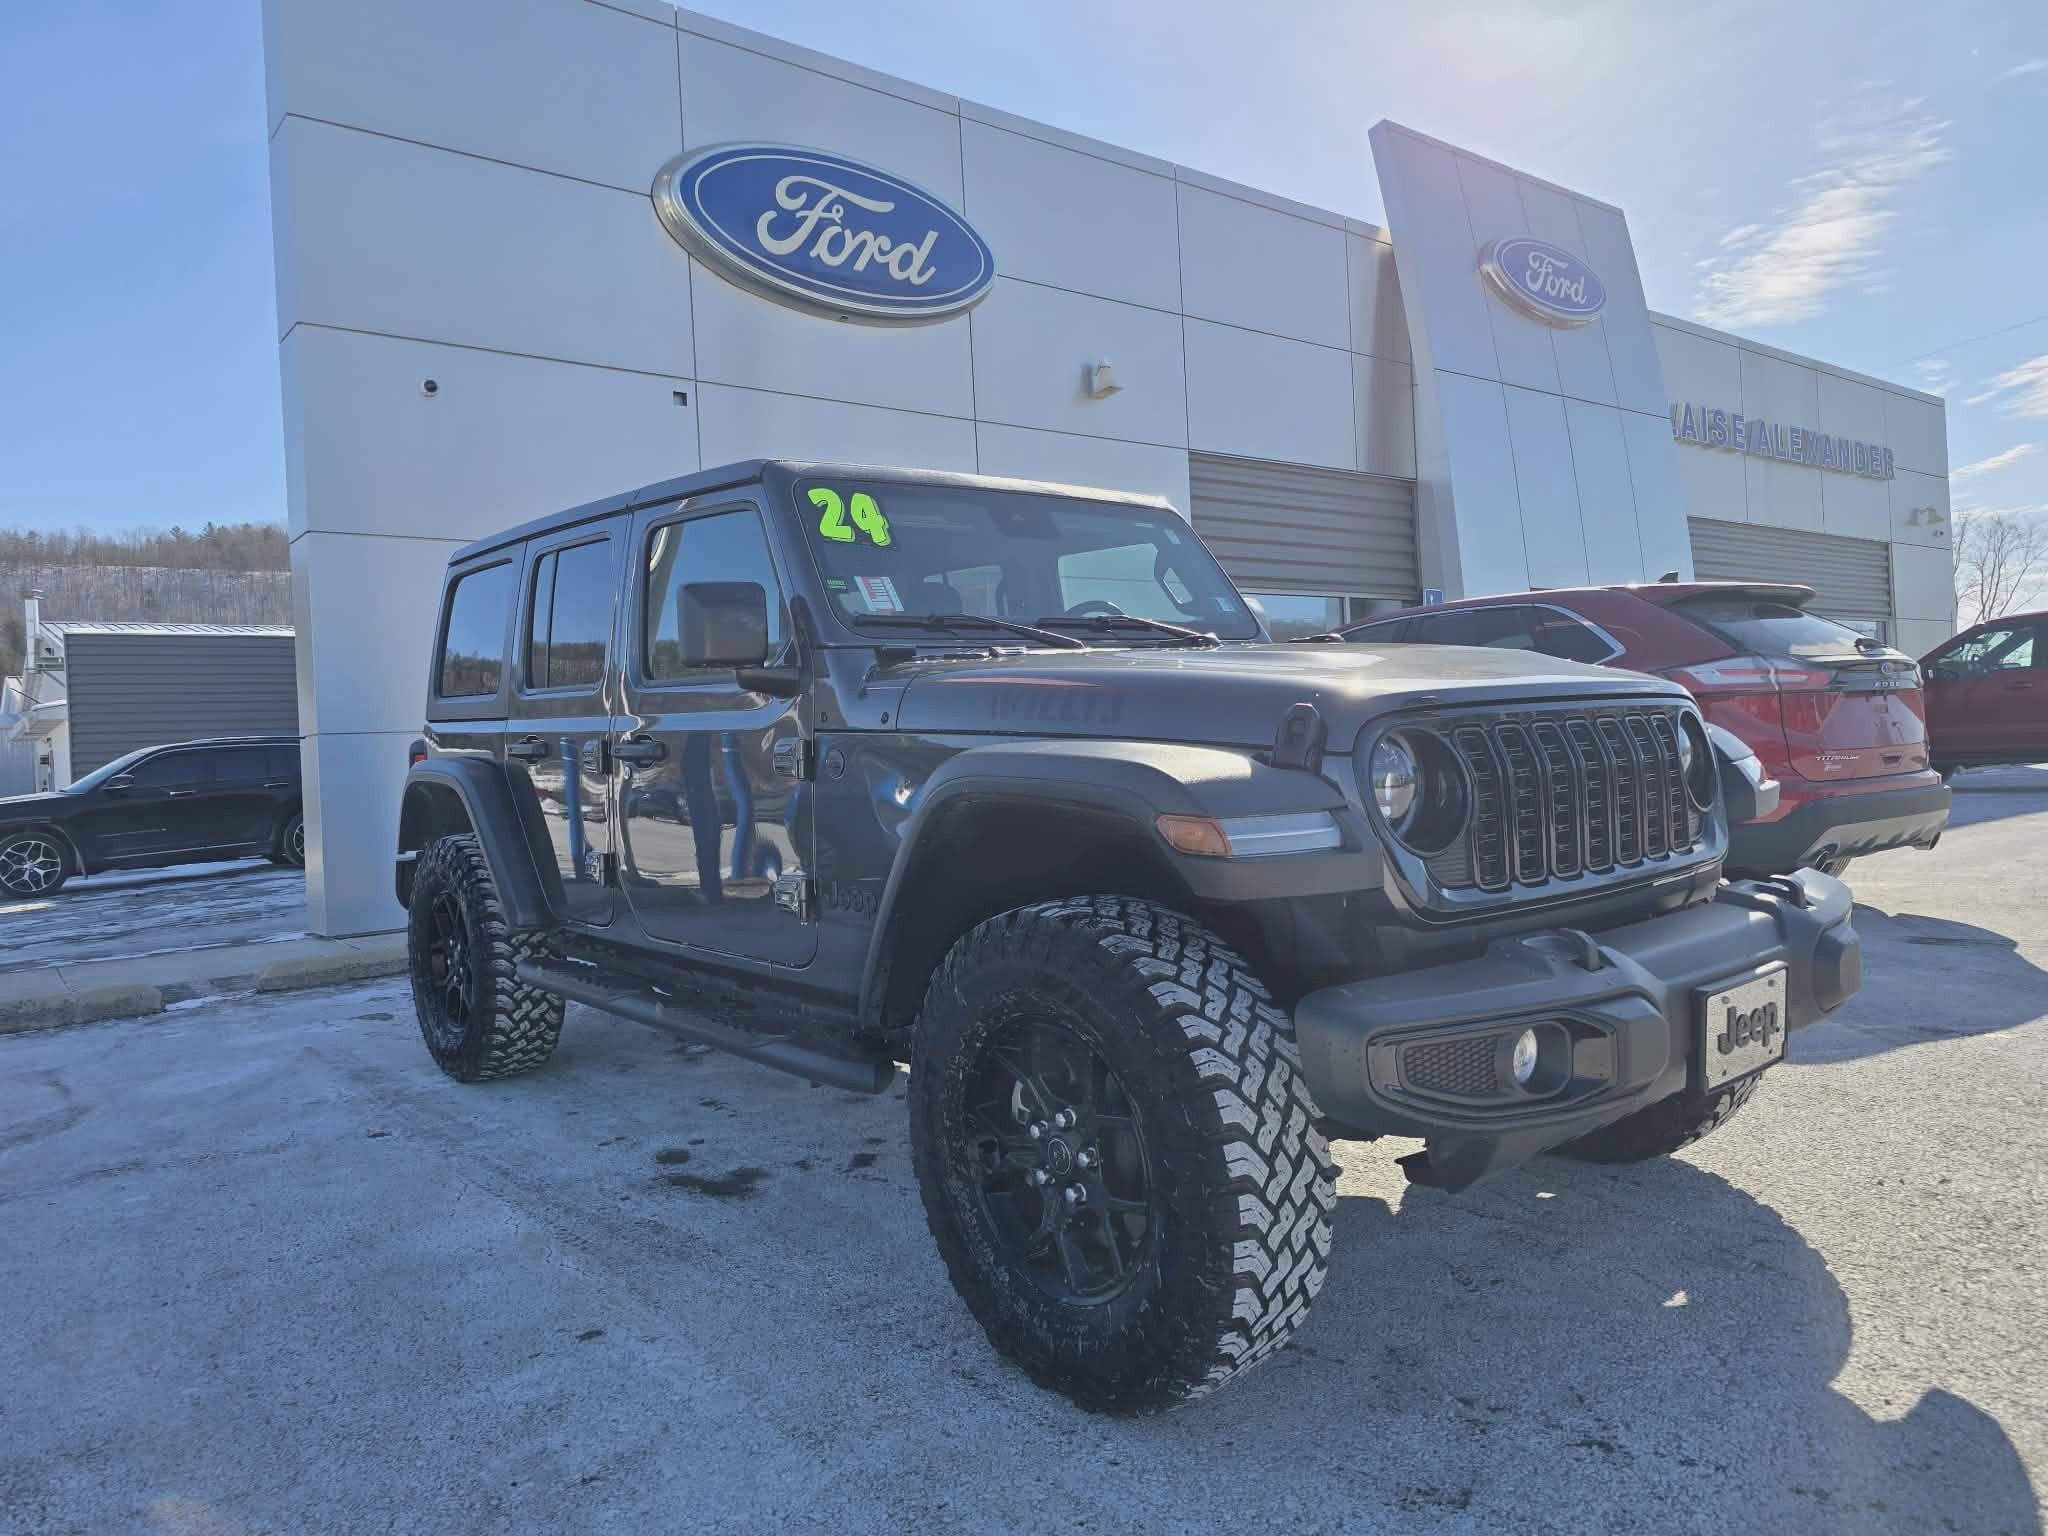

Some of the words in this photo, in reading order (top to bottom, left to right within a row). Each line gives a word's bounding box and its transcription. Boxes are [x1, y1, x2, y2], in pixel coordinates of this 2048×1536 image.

[757, 175, 938, 286] Ford
[1526, 250, 1588, 304] Ford
[1672, 402, 1745, 450] AISE
[1747, 418, 1895, 481] ALEXANDER
[808, 488, 892, 546] 24
[1717, 1001, 1778, 1055] Jeep
